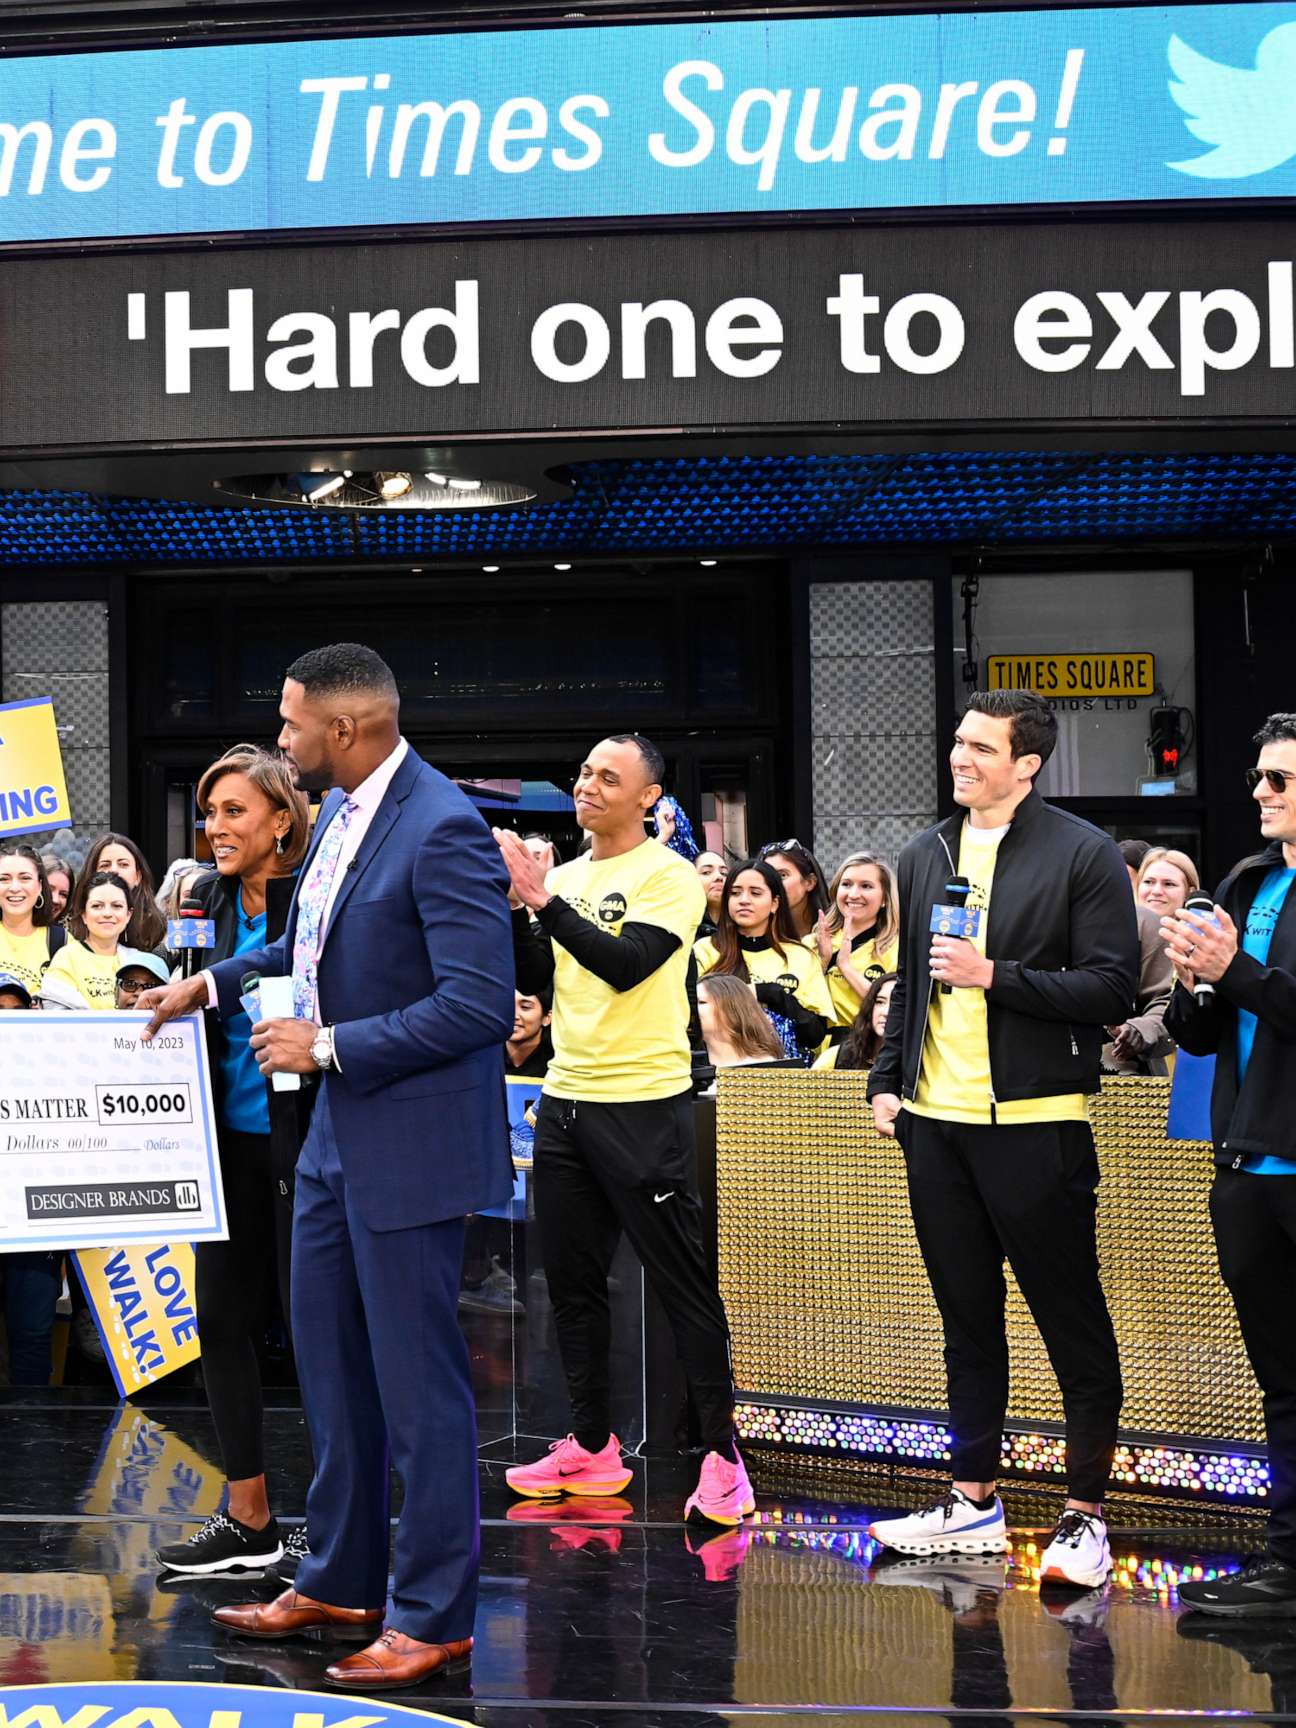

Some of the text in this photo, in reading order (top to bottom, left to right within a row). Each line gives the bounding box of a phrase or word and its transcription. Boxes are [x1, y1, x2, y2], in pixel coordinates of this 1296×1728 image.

[155, 97, 252, 188] to
[298, 73, 610, 182] Times
[648, 48, 1085, 192] Square!
[127, 260, 1295, 397] 'Hard one to expl
[995, 659, 1147, 690] TIMES SQUARE
[1105, 698, 1138, 710] LTD
[599, 900, 626, 912] GMA
[114, 1037, 184, 1052] May 10, 2023
[15, 1097, 89, 1120] MATTER
[102, 1092, 186, 1117] $10,000
[6, 1133, 60, 1152] Dollars
[144, 1137, 181, 1152] Dollars
[30, 1188, 171, 1212] DESIGNER BRANDS
[144, 1244, 199, 1347] LOVE
[104, 1249, 166, 1374] WALK!
